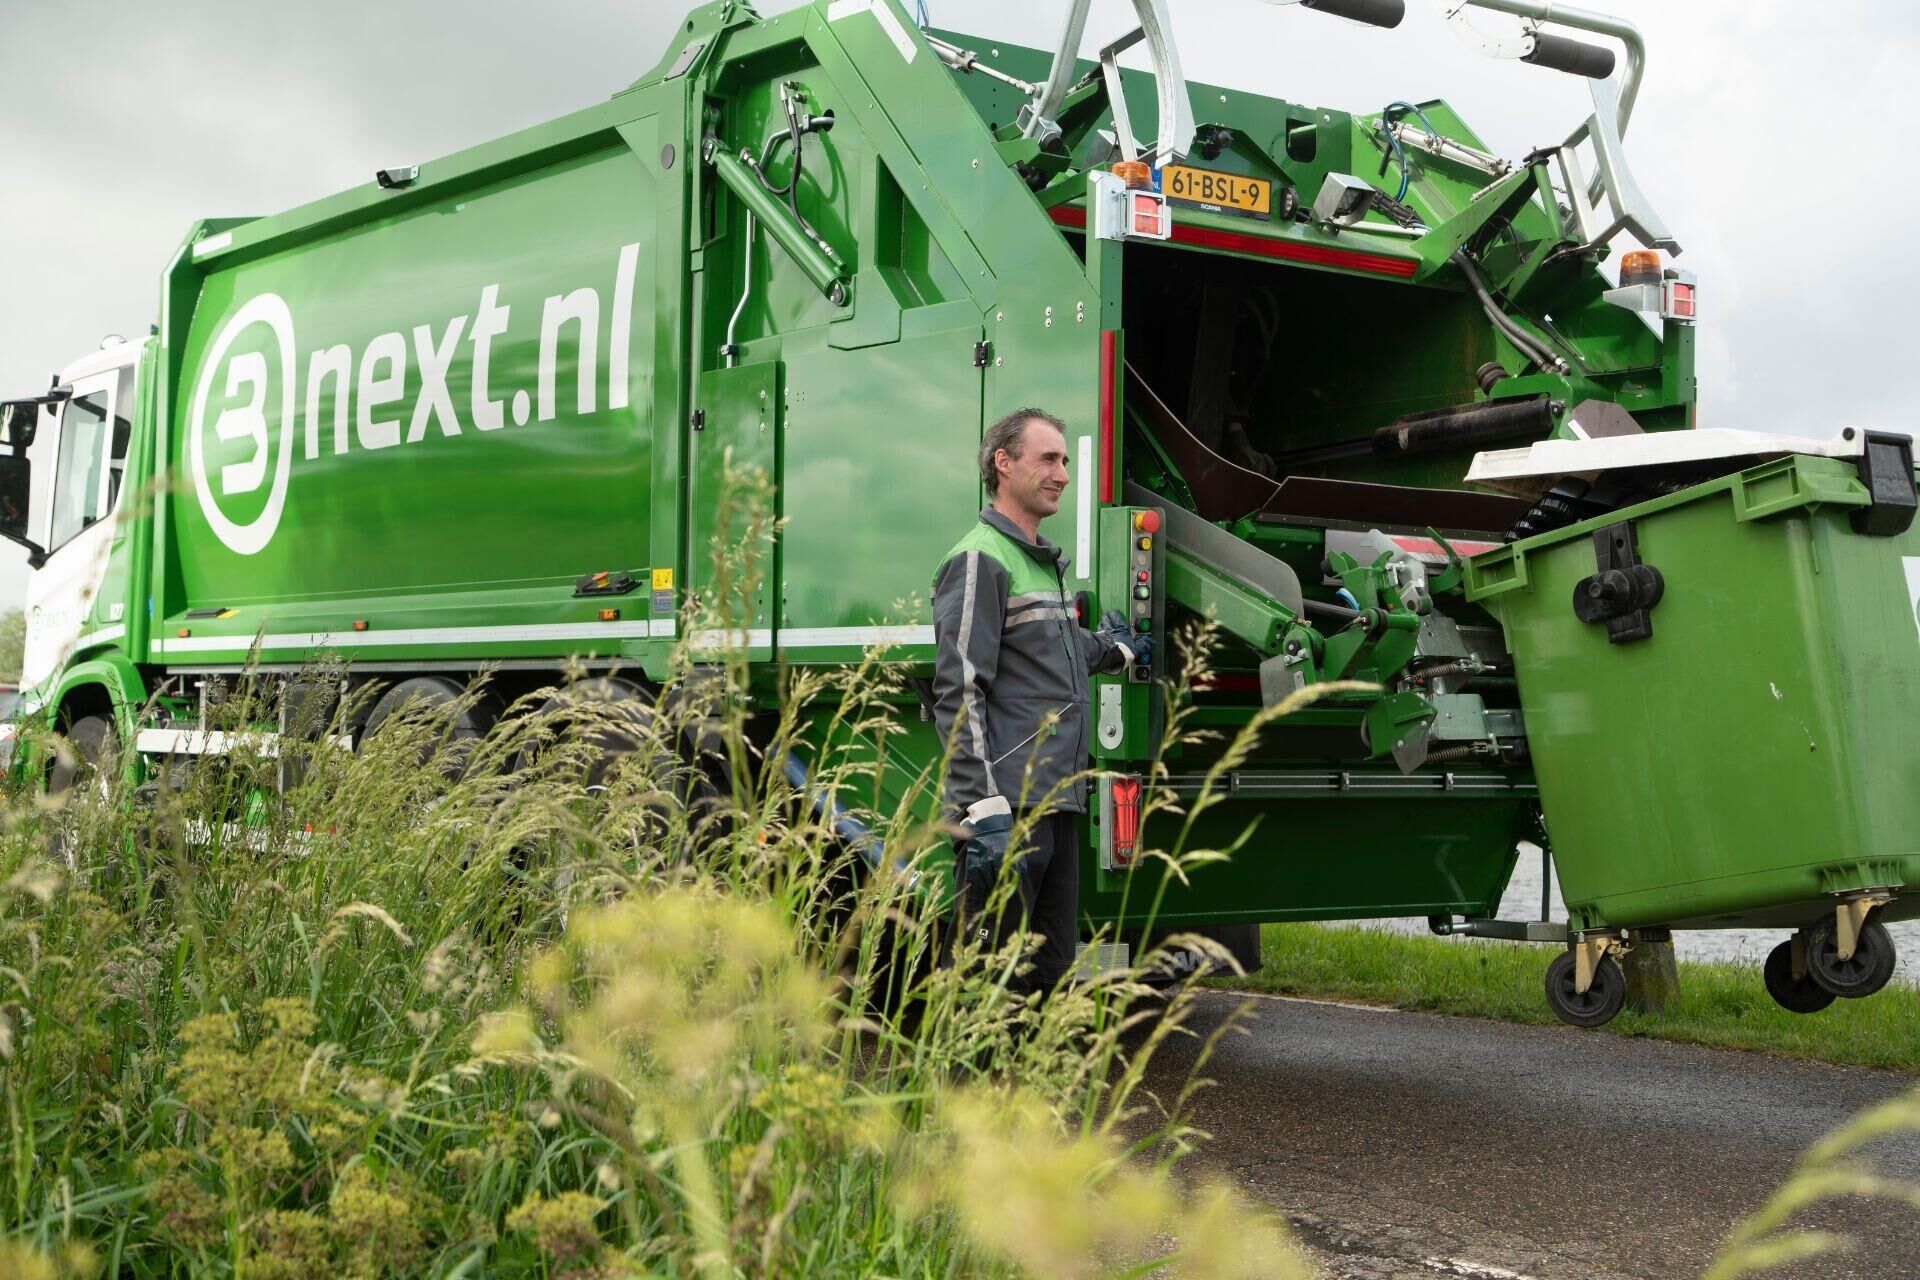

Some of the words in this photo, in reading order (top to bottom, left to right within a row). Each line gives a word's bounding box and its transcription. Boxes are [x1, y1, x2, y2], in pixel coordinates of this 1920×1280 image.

[1152, 181, 1161, 190] NL
[1172, 170, 1260, 206] 61-BSL-9
[1200, 203, 1222, 212] SCANIA
[305, 242, 640, 460] next.nl
